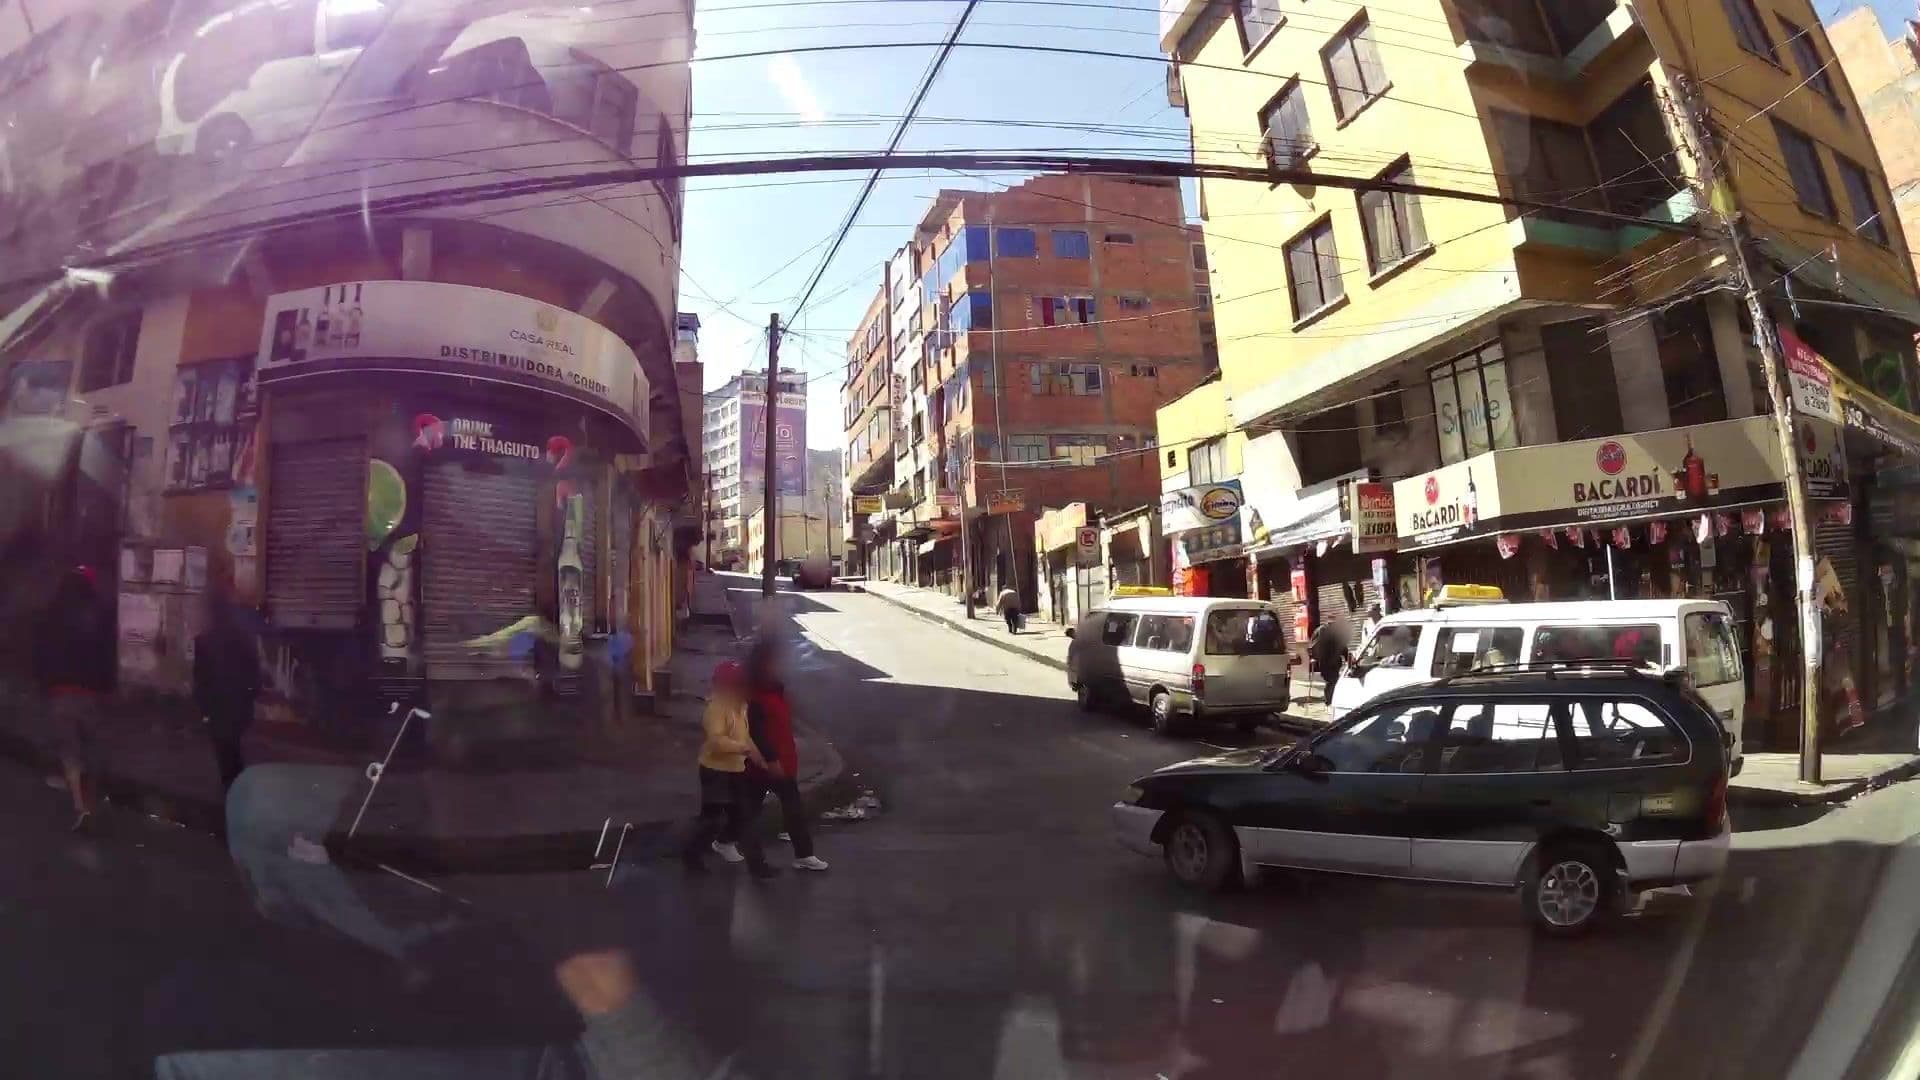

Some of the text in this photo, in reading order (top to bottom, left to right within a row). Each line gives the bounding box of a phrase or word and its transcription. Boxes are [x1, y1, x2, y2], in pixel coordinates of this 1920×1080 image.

[510, 329, 575, 356] CASA REAL
[453, 418, 492, 434] DRINK
[453, 434, 477, 450] THE
[1573, 466, 1661, 503] BACARDÍ
[1412, 496, 1460, 530] BACARDÍ
